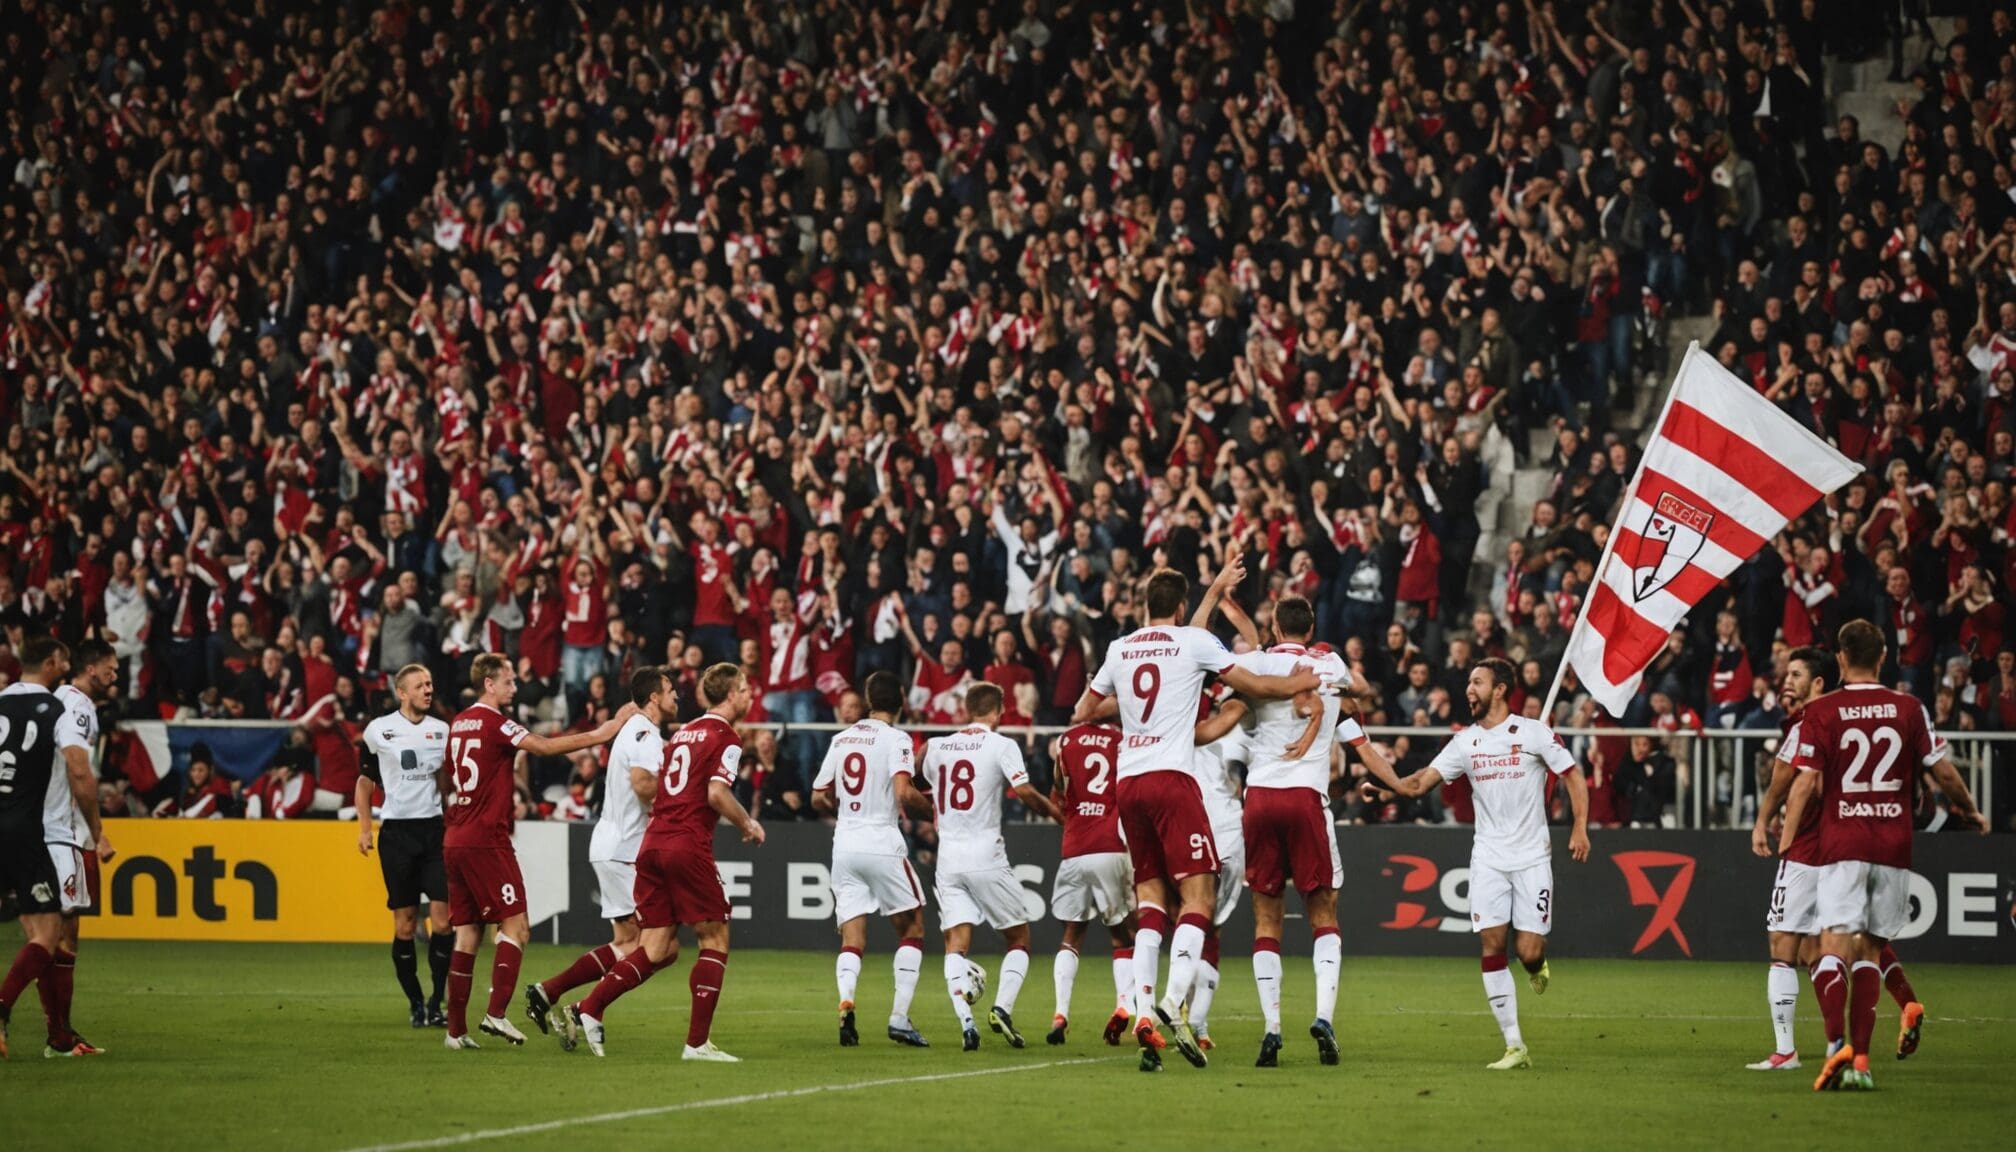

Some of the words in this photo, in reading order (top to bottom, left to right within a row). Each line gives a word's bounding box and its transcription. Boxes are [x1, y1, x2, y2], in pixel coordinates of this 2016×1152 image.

[1132, 663, 1161, 724] 9
[842, 751, 867, 796] 9
[938, 759, 975, 815] 18
[1084, 752, 1110, 795] 2
[1839, 726, 1903, 793] 22
